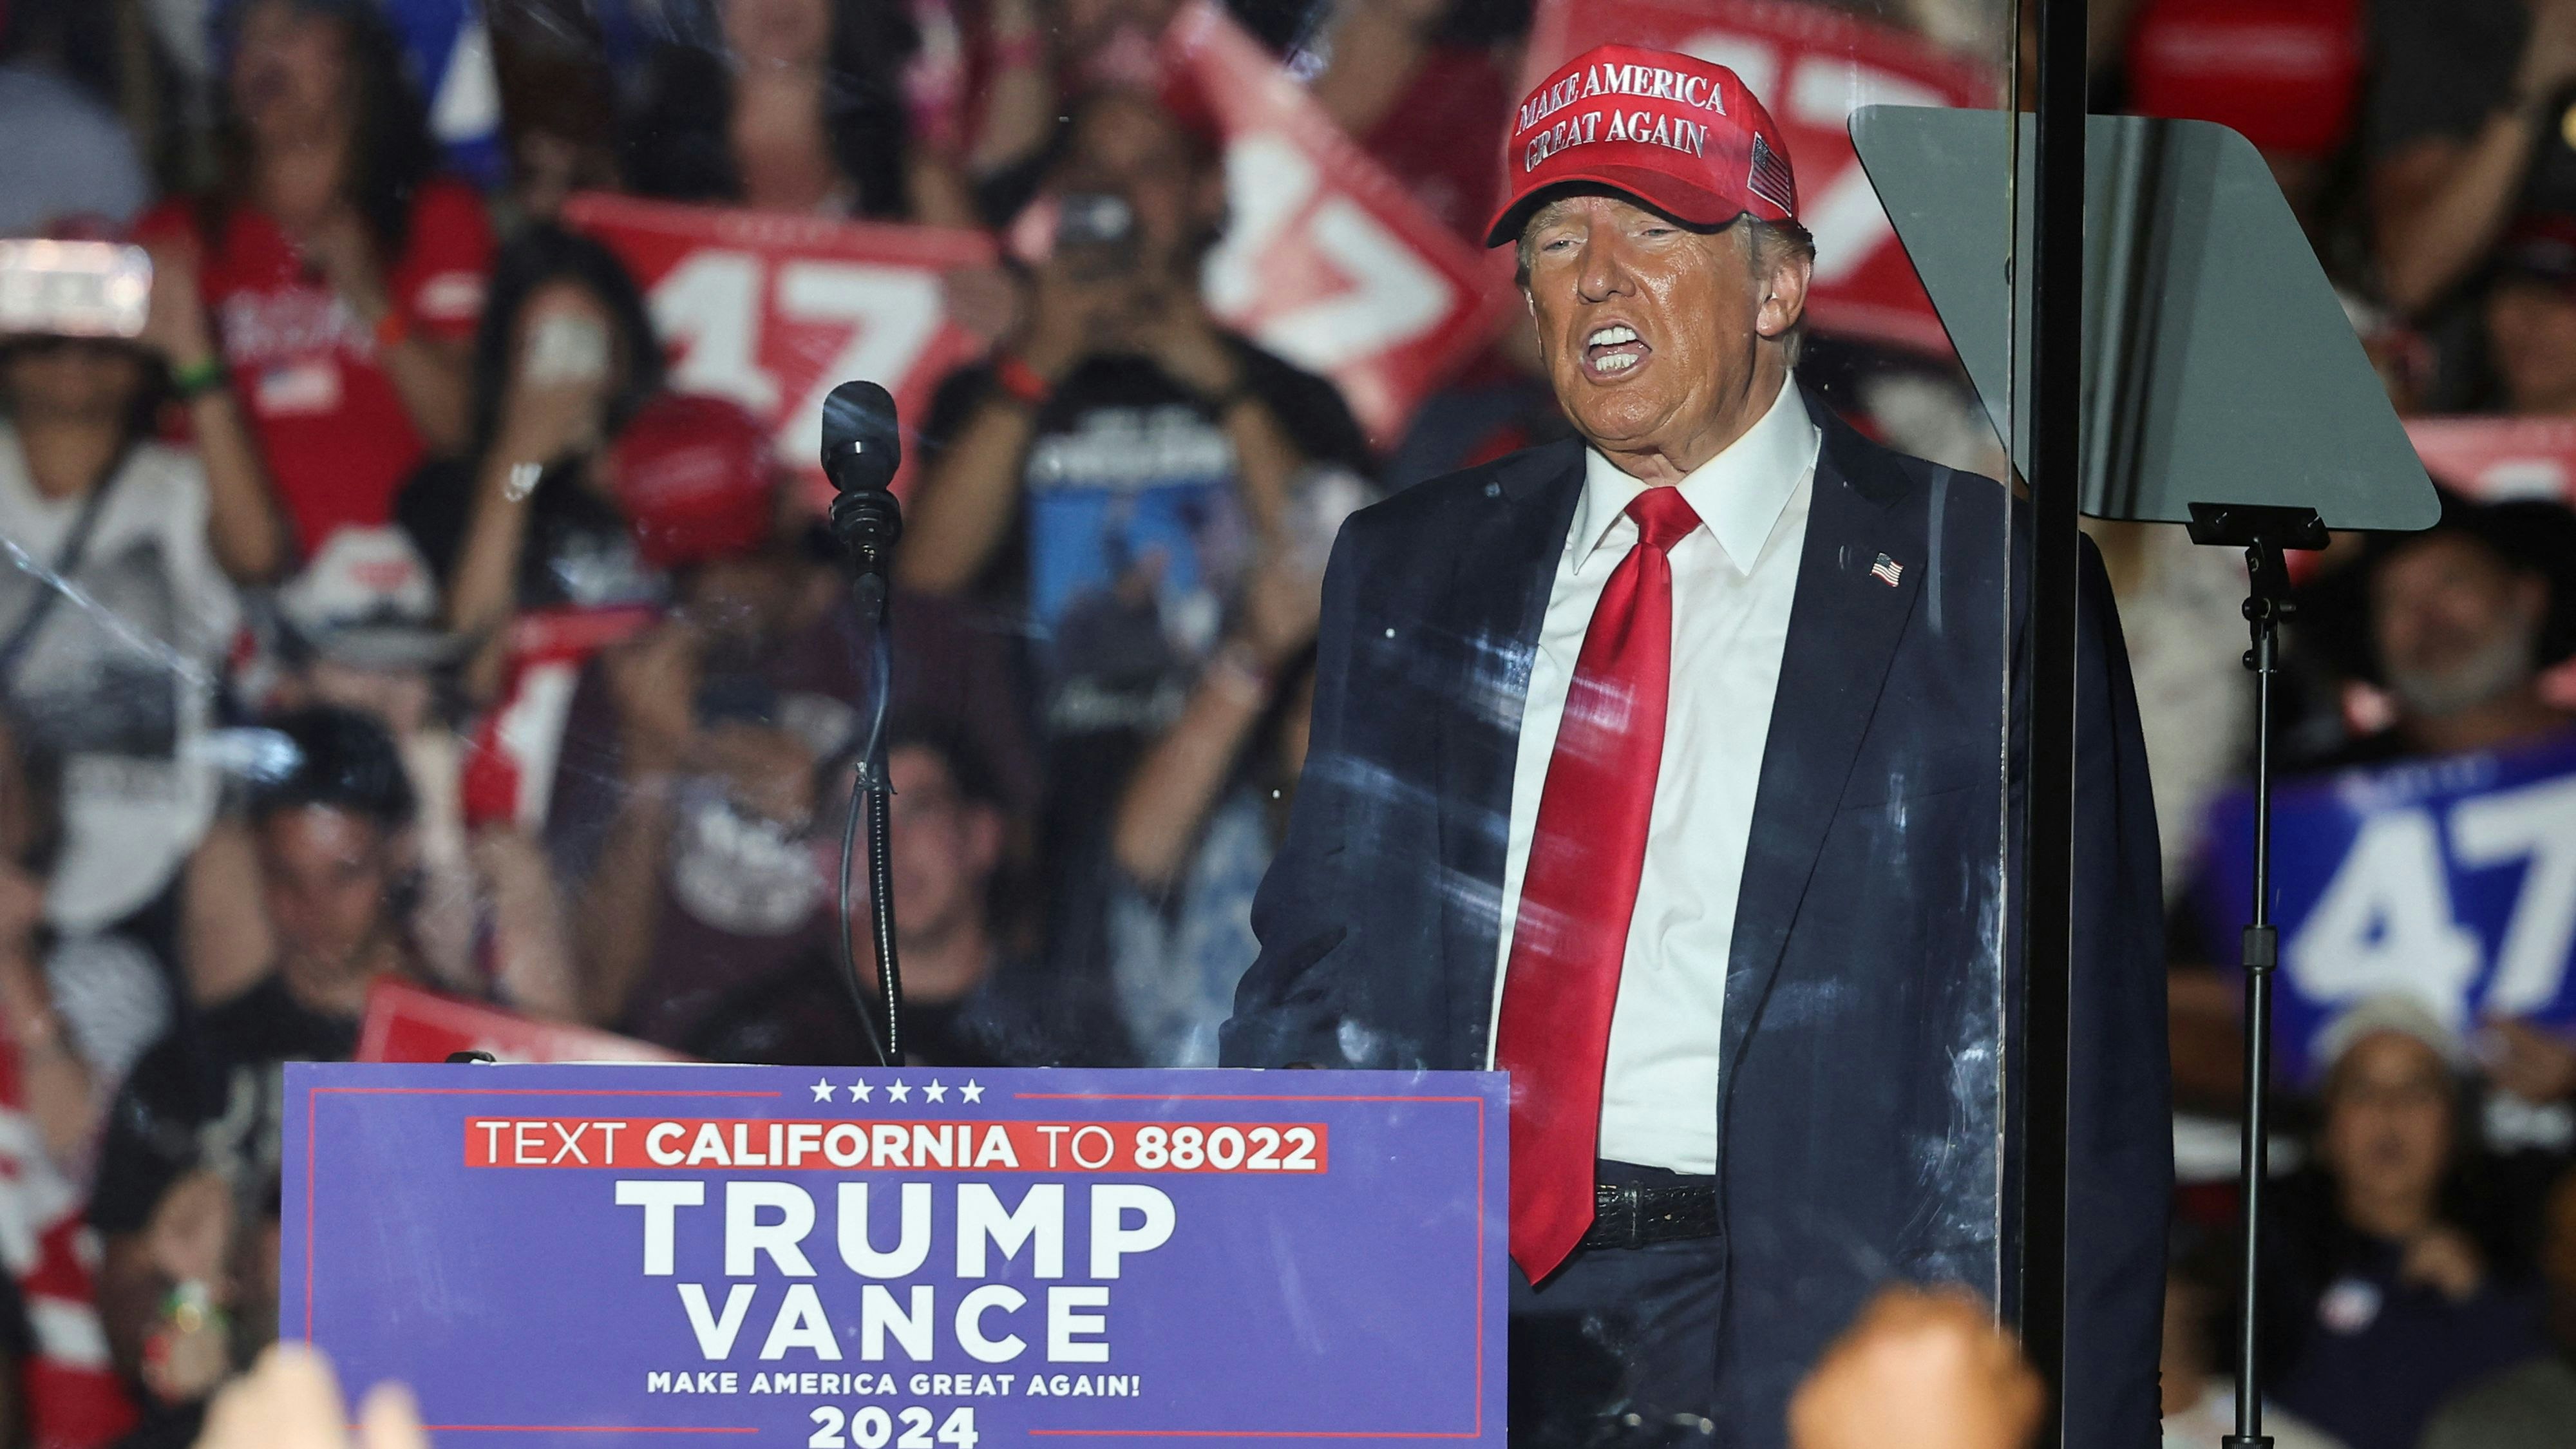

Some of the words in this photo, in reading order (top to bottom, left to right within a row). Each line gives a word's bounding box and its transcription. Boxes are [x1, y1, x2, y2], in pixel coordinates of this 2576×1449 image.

[1515, 71, 1580, 137] MAKE
[1580, 62, 1727, 117] AMERICA
[1524, 111, 1602, 173] GREAT
[1605, 108, 1708, 159] AGAIN
[2283, 775, 2576, 1037] 47
[475, 1121, 627, 1165] TEXT
[645, 1121, 1019, 1168] CALIFORNIA
[1036, 1125, 1115, 1170] TO
[1133, 1126, 1316, 1171] 88022
[614, 1180, 1176, 1280] TRUMP
[676, 1283, 1110, 1363] VANCE
[647, 1371, 738, 1394] MAKE
[748, 1372, 898, 1396] AMERICA
[909, 1374, 1016, 1396] GREAT
[1026, 1374, 1141, 1397] AGAIN!
[808, 1405, 979, 1449] 2024
